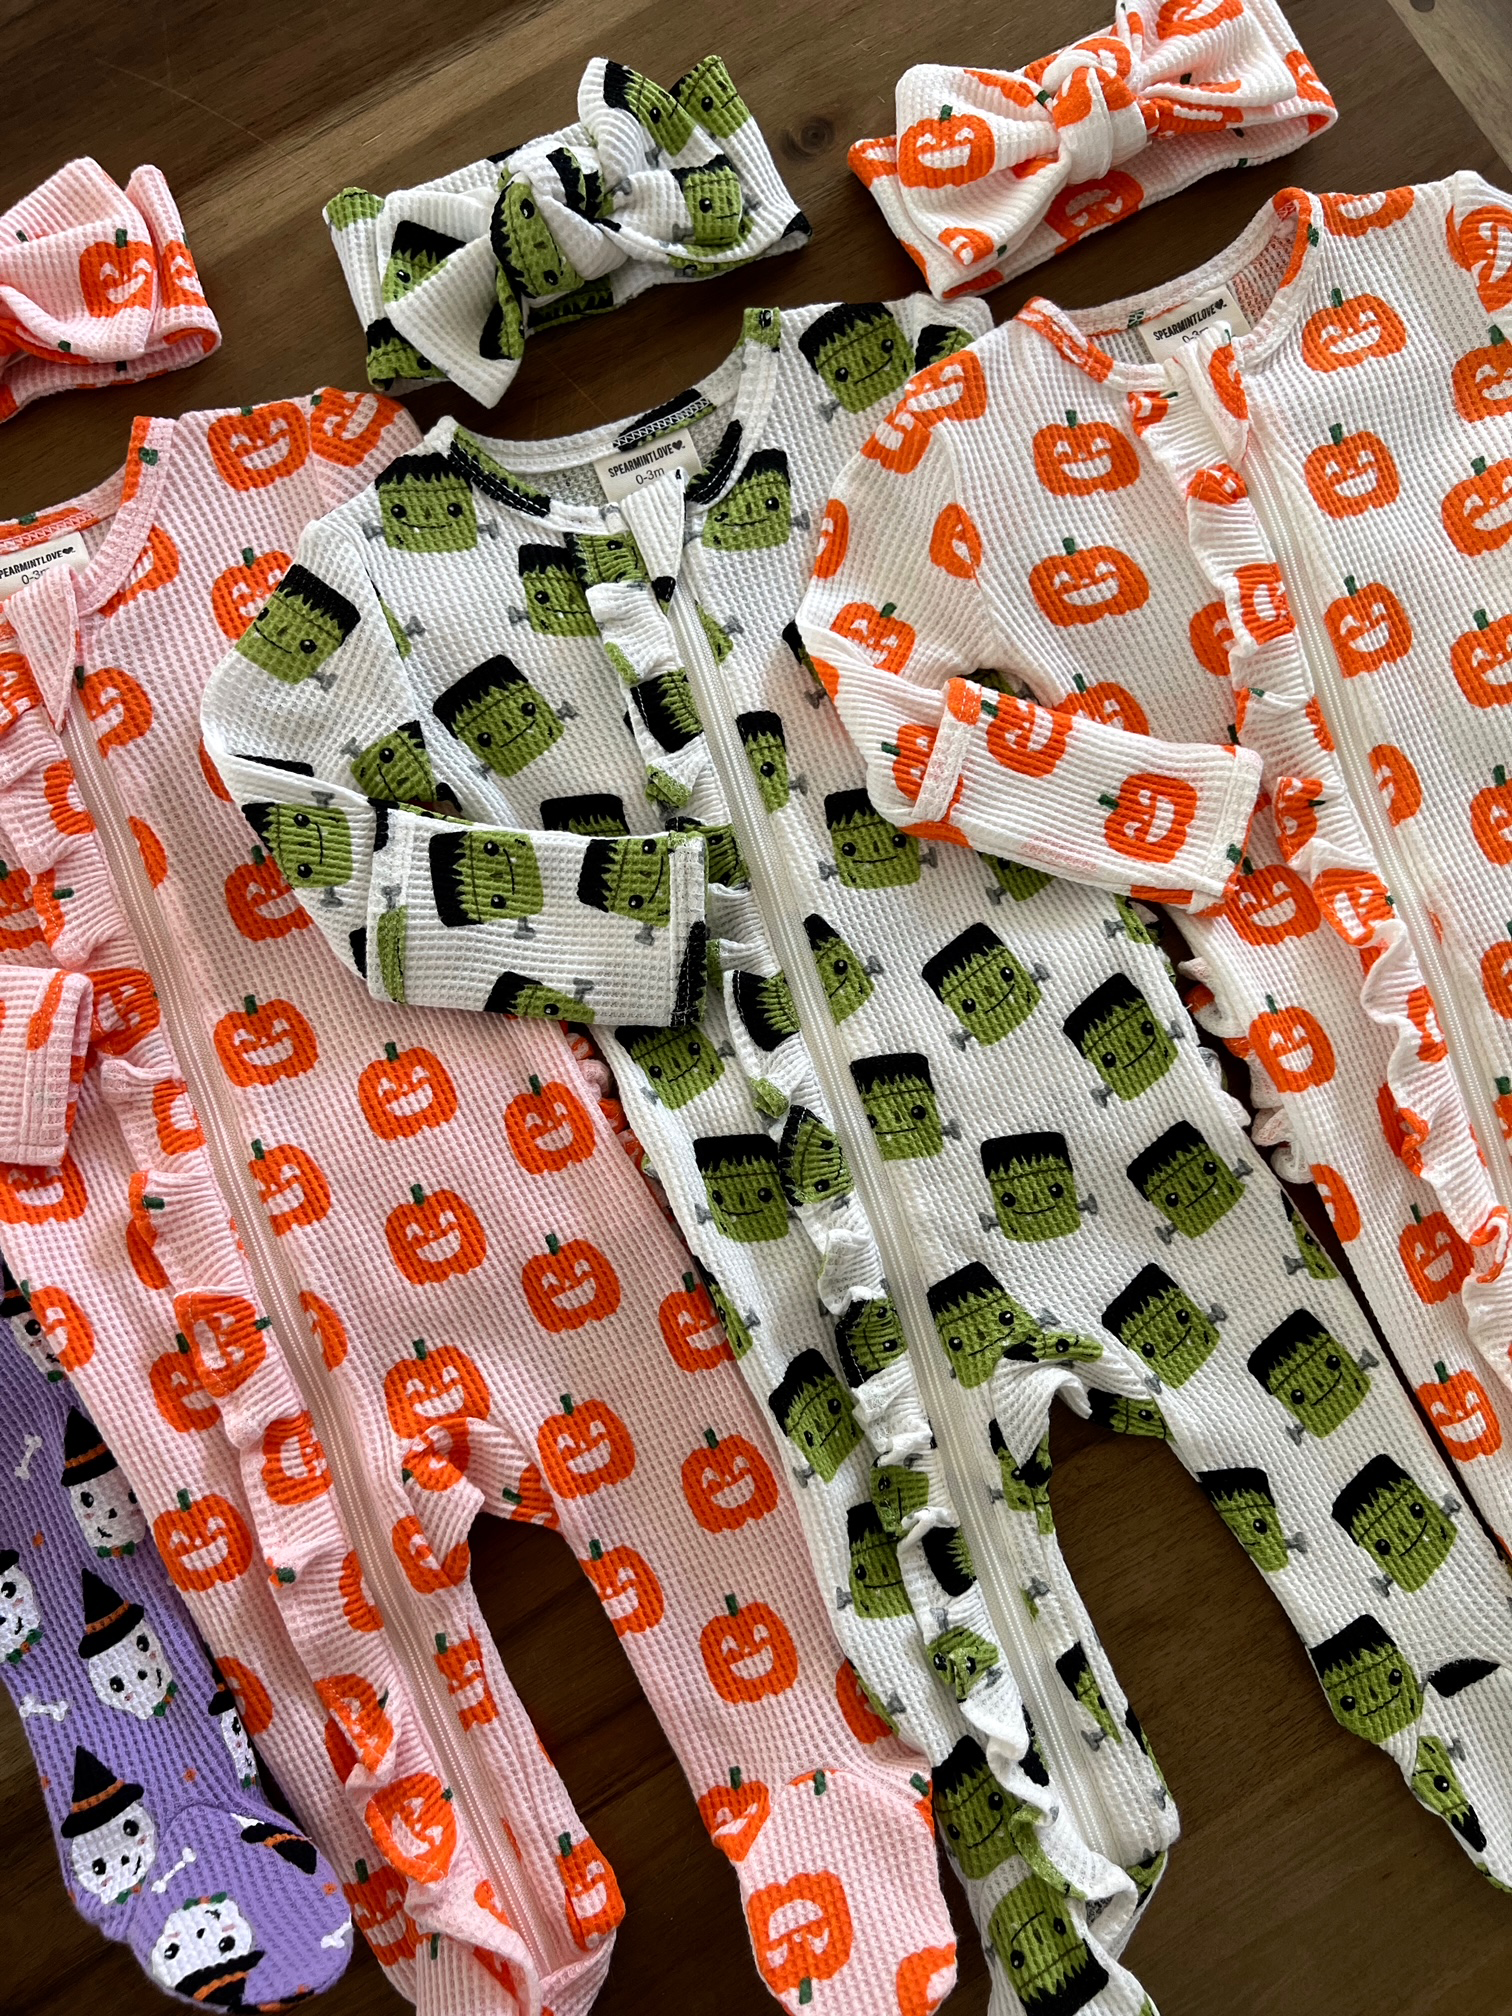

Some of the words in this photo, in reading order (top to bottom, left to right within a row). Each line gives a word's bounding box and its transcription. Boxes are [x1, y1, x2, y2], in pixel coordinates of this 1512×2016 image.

[1153, 306, 1216, 341] SPEARMINTLOVE
[608, 444, 674, 477] SPEARMINTLOVE
[635, 467, 665, 485] 0-3m
[0, 550, 63, 579] PEARMINTLOVE
